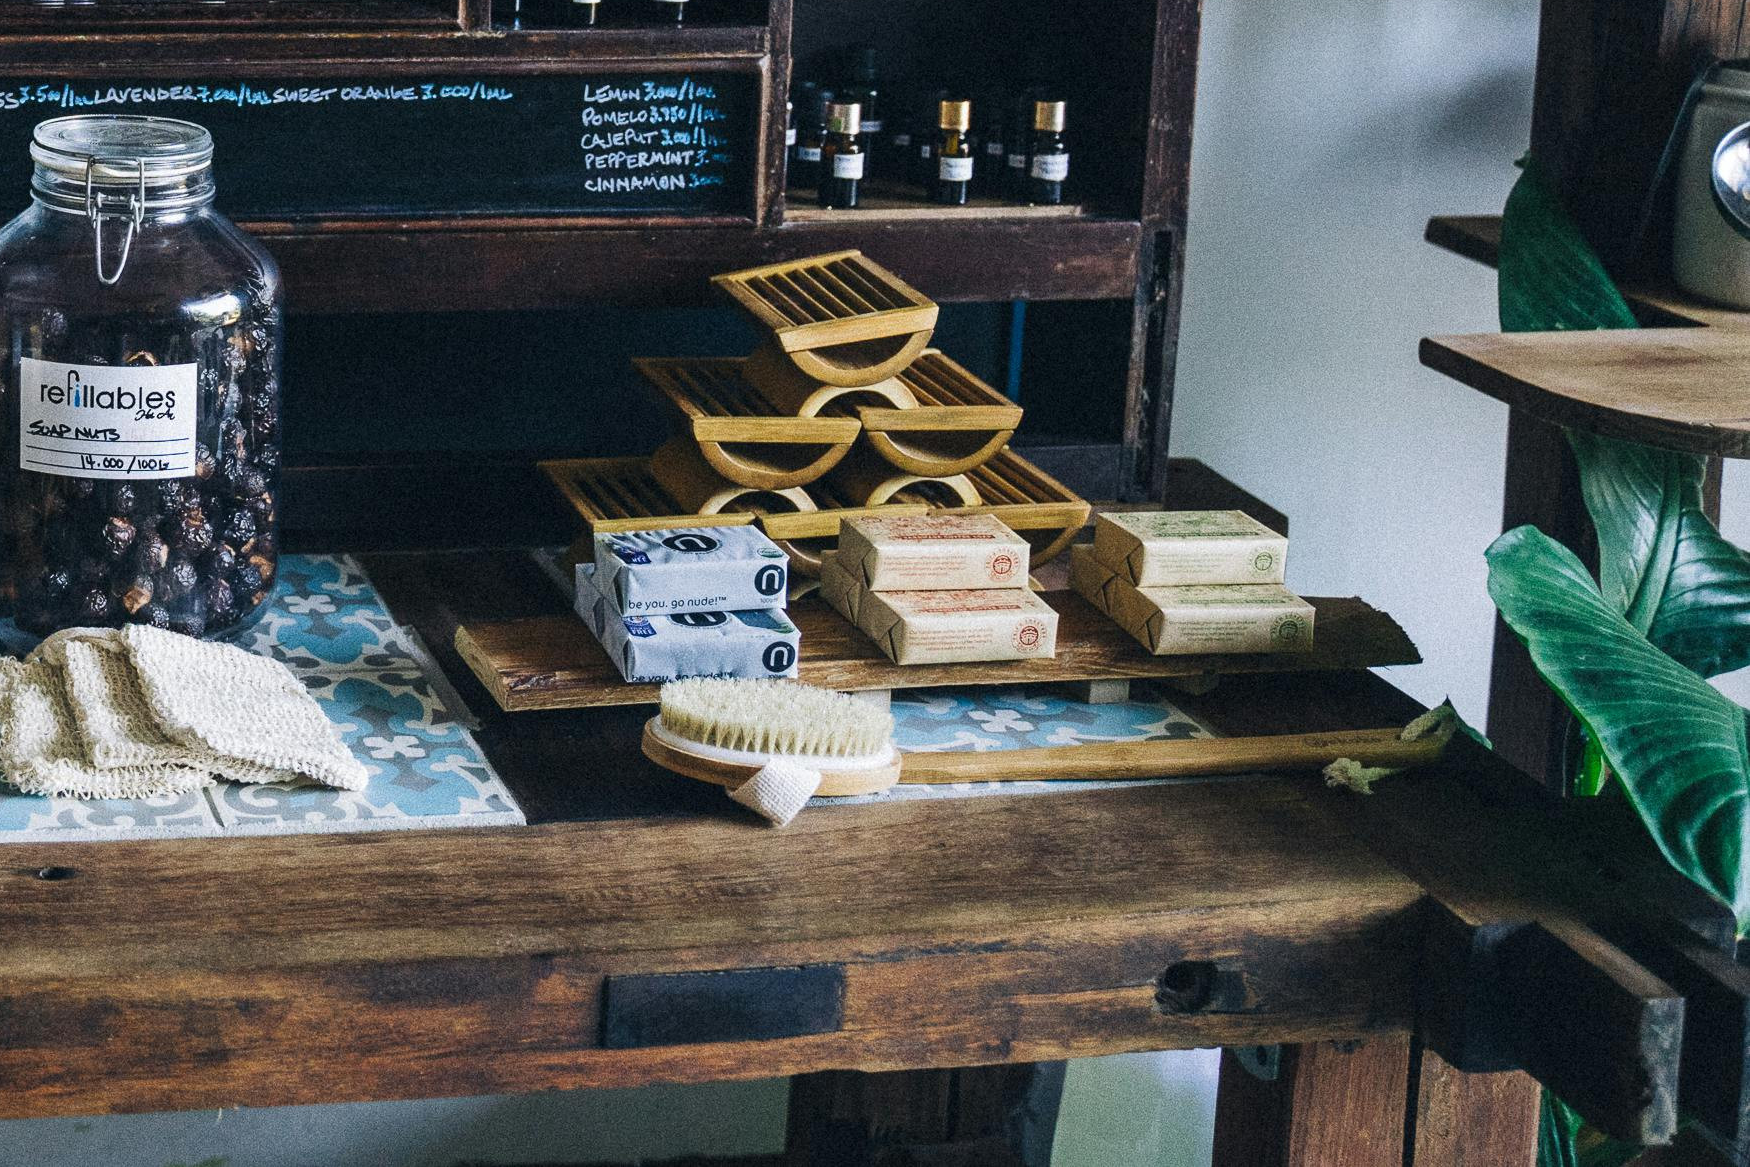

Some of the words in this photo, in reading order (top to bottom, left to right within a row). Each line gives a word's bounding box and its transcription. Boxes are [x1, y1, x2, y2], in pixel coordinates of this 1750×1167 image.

[272, 86, 338, 104] SWEET
[340, 85, 418, 101] ORANGE
[584, 84, 640, 103] LEMON
[581, 106, 647, 126] POMELO
[581, 128, 658, 149] CAJEPUT
[585, 150, 694, 170] PEPPERMINT
[584, 174, 685, 193] CINNAMON
[40, 370, 176, 409] refillables
[28, 420, 72, 438] SOAP
[75, 426, 121, 442] NUTS
[628, 599, 643, 609] be
[671, 600, 685, 609] go
